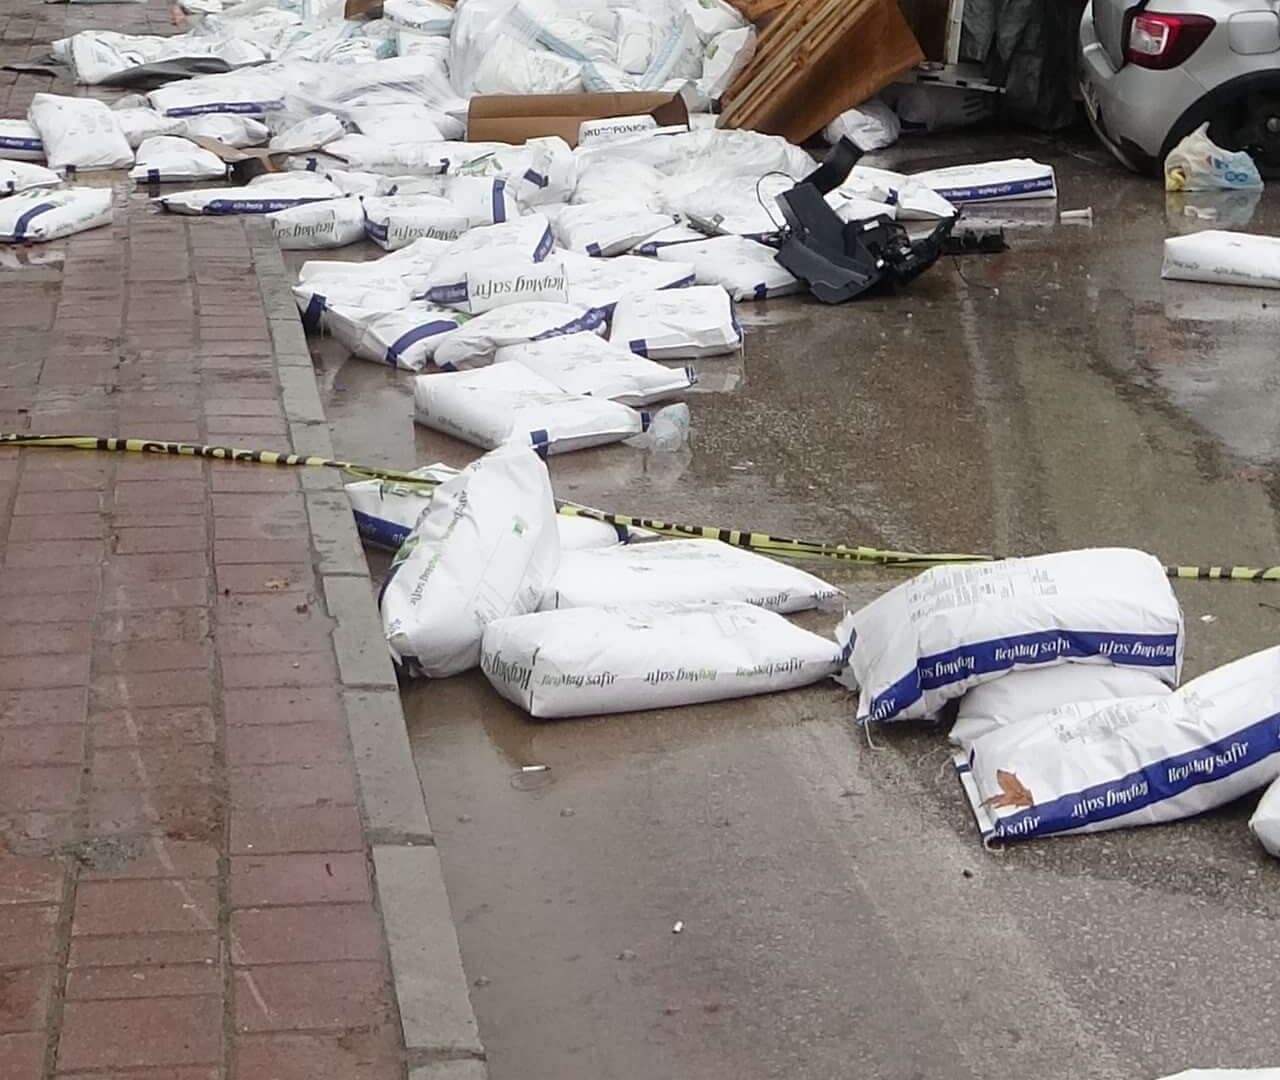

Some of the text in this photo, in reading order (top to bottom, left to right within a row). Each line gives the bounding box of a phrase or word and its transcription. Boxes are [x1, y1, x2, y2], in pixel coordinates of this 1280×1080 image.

[475, 274, 565, 300] KeyMag safir
[995, 642, 1039, 661] KeyMag
[773, 657, 805, 675] safir
[584, 670, 618, 686] safir
[643, 670, 675, 686] safir
[1168, 741, 1250, 783] KeyMag safir
[1071, 779, 1149, 818] KeyMag safir
